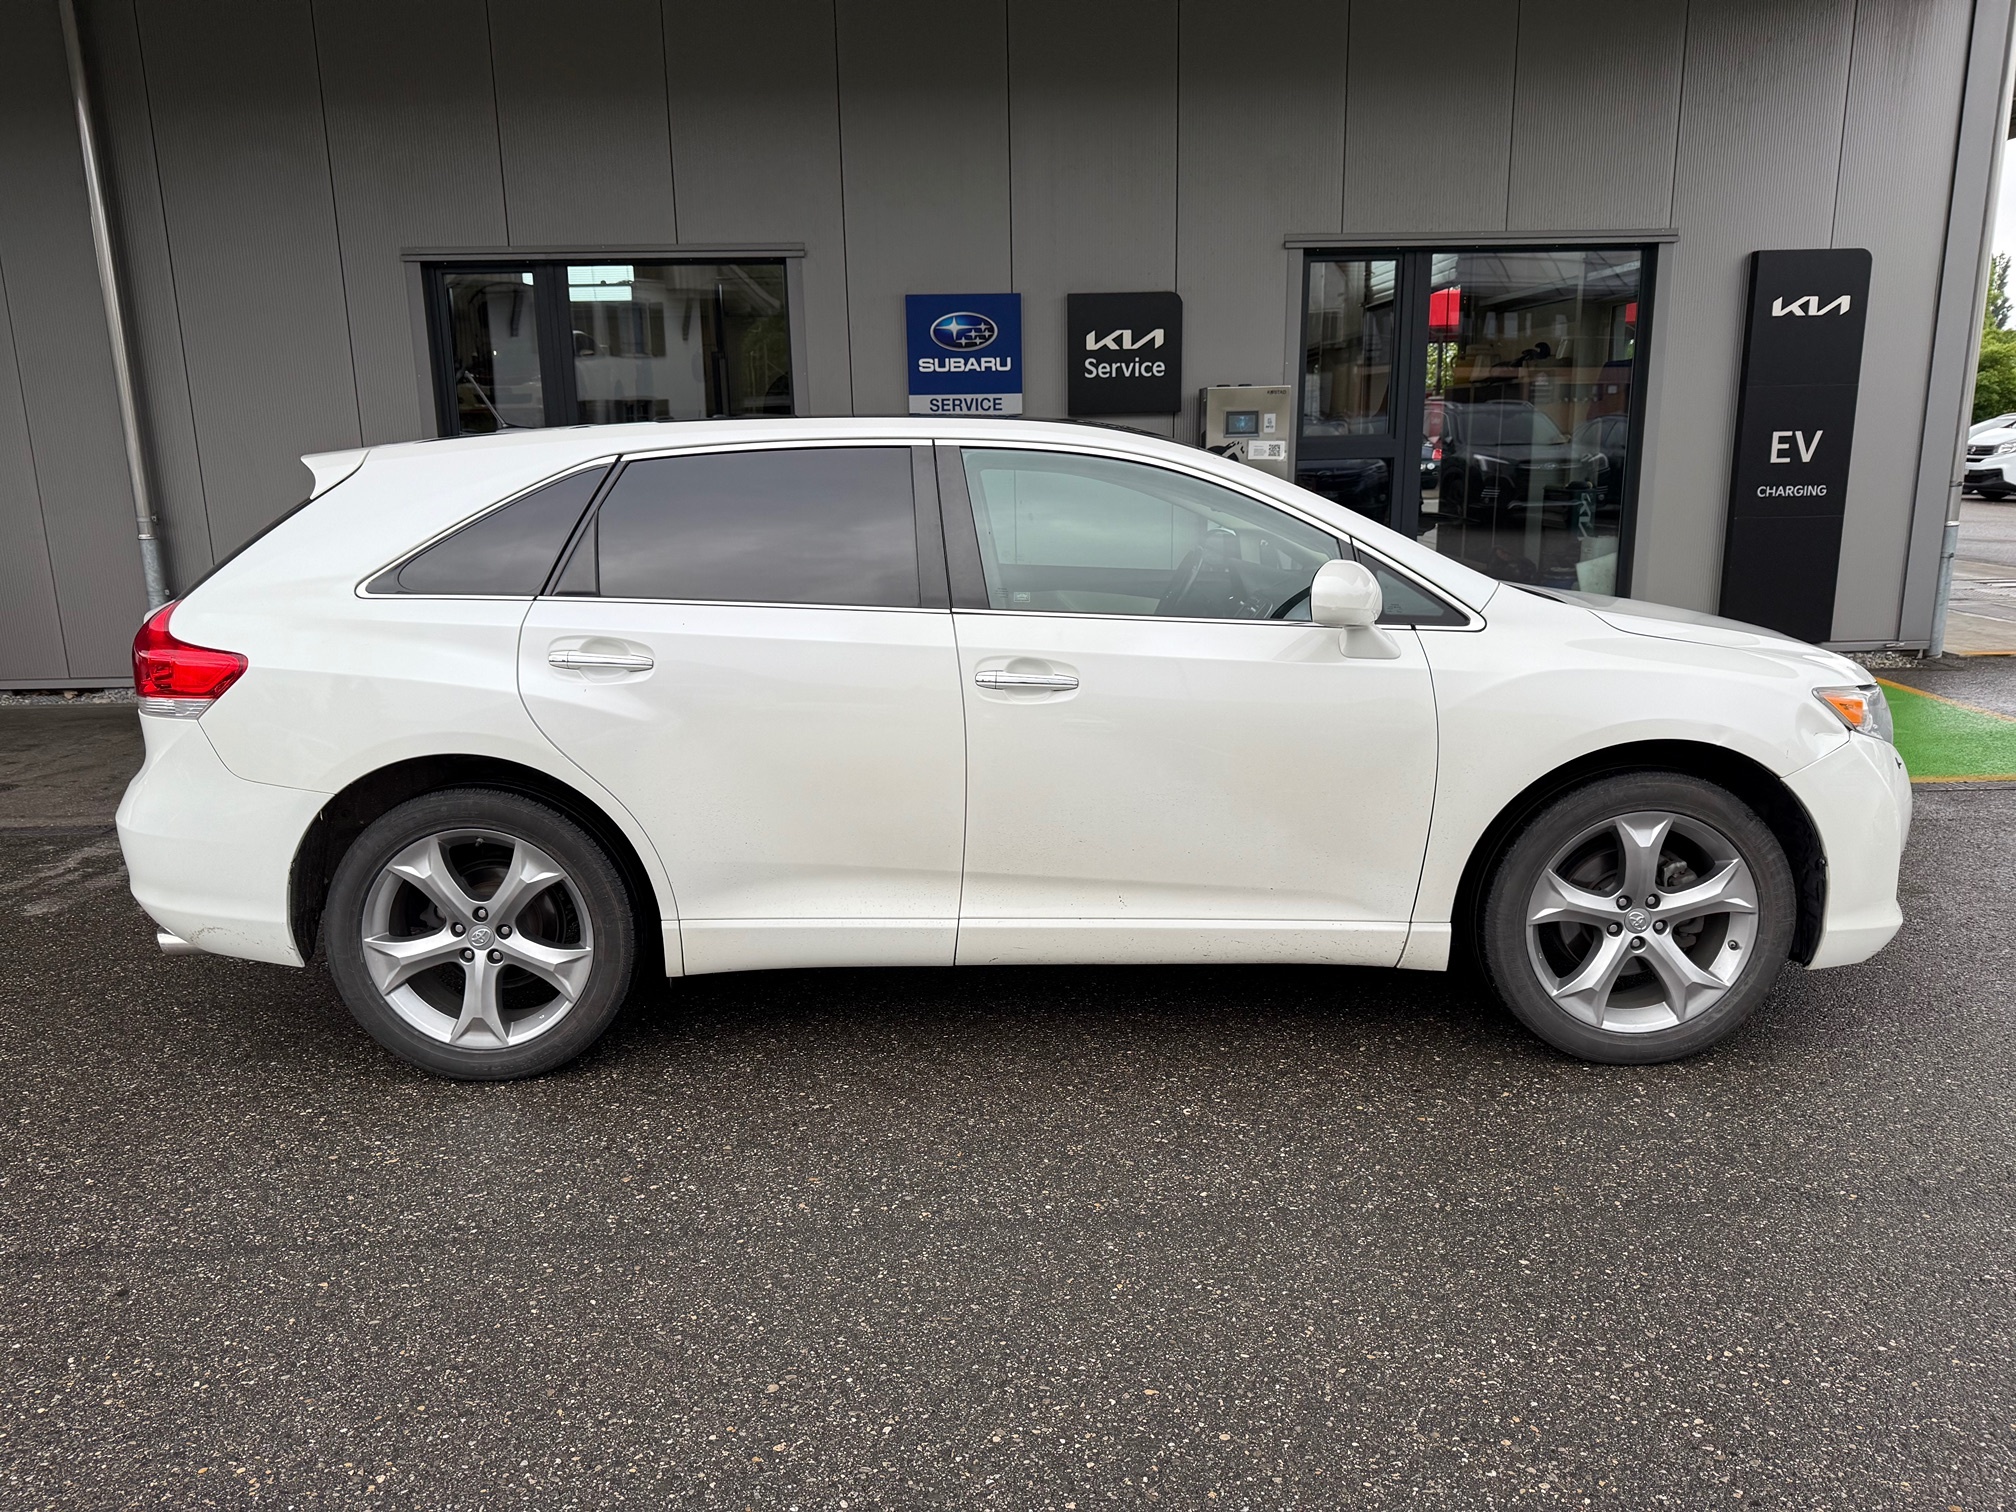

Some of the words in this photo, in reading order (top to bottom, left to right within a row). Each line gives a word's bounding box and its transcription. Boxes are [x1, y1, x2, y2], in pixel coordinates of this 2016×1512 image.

[1771, 295, 1850, 317] KIA
[1086, 328, 1165, 351] KIA
[918, 357, 1012, 373] SUBARU
[1084, 357, 1166, 378] Service
[929, 398, 1003, 412] SERVICE
[1769, 430, 1823, 464] EV
[1757, 485, 1827, 498] CHARGING
